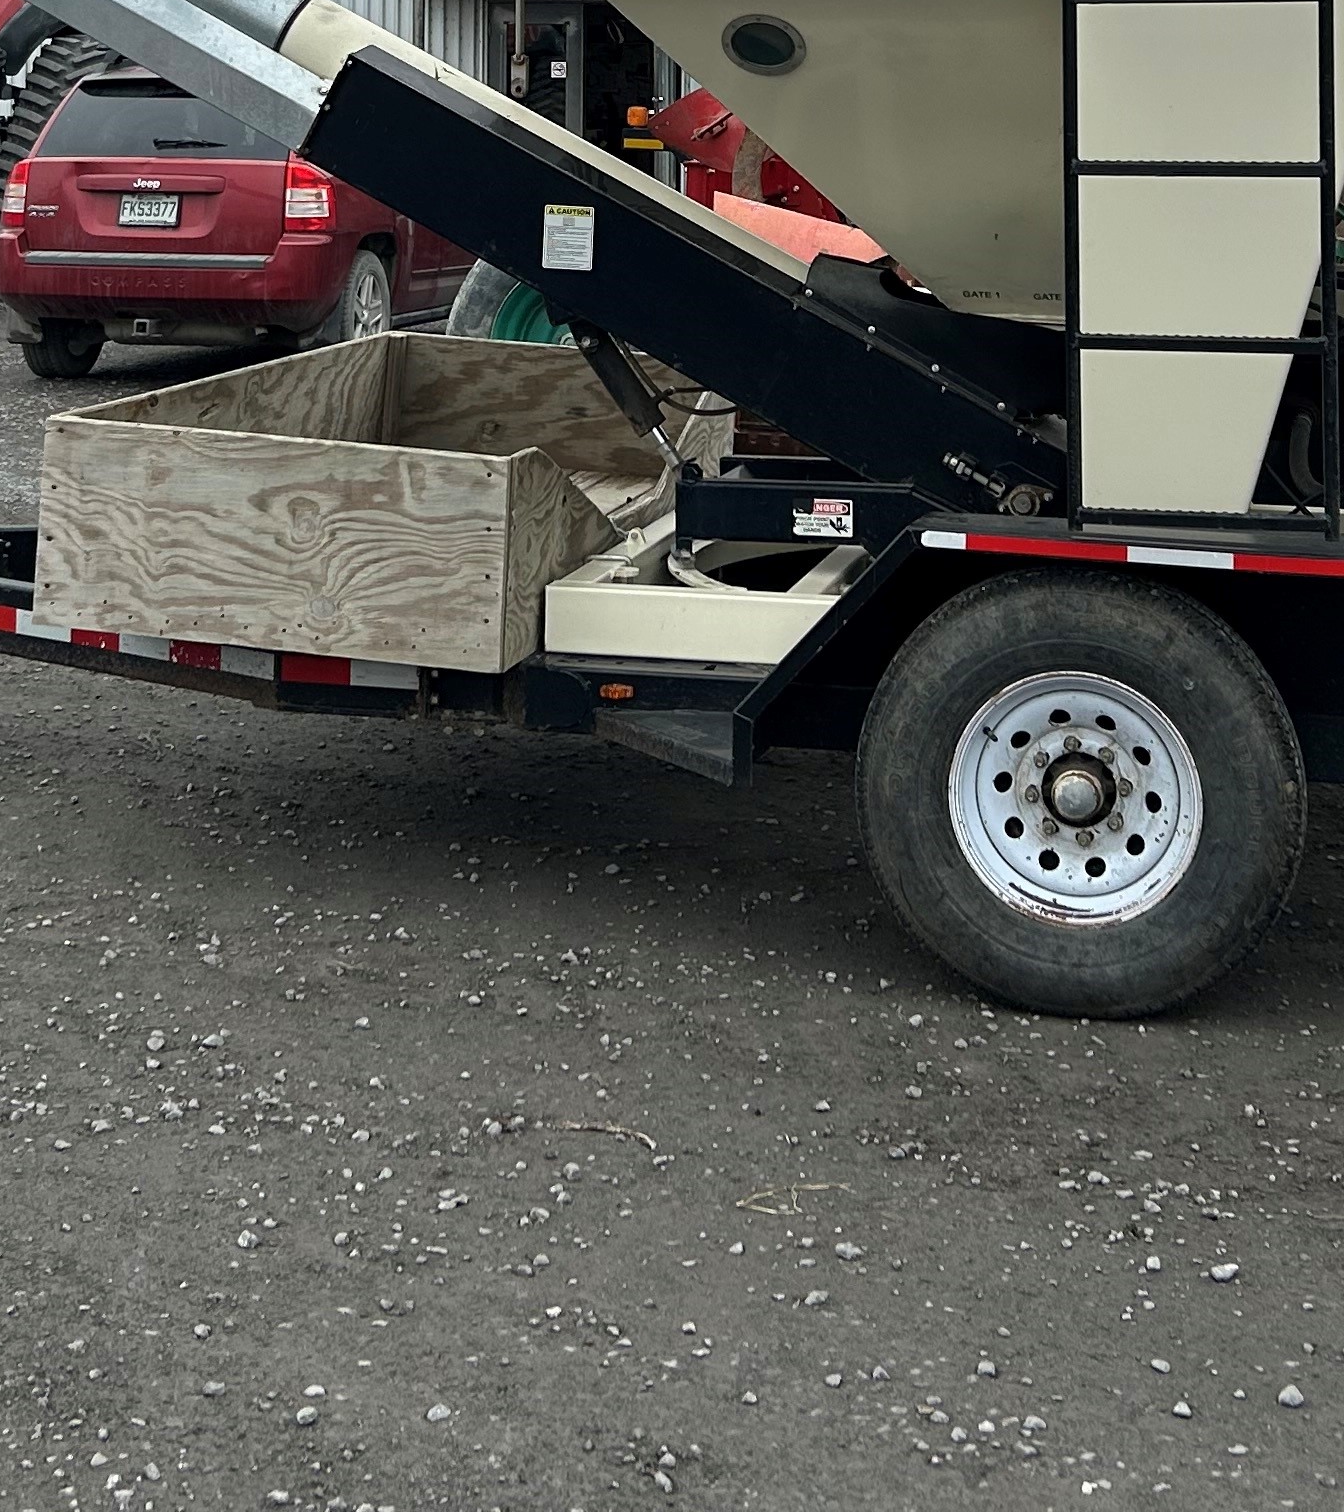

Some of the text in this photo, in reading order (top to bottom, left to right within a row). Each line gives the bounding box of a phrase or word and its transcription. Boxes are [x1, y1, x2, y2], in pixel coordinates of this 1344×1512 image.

[133, 177, 161, 190] Jeep
[121, 200, 177, 218] FKS3377
[556, 207, 591, 217] CAUTION
[962, 290, 992, 299] GATE
[1033, 292, 1063, 301] GATE
